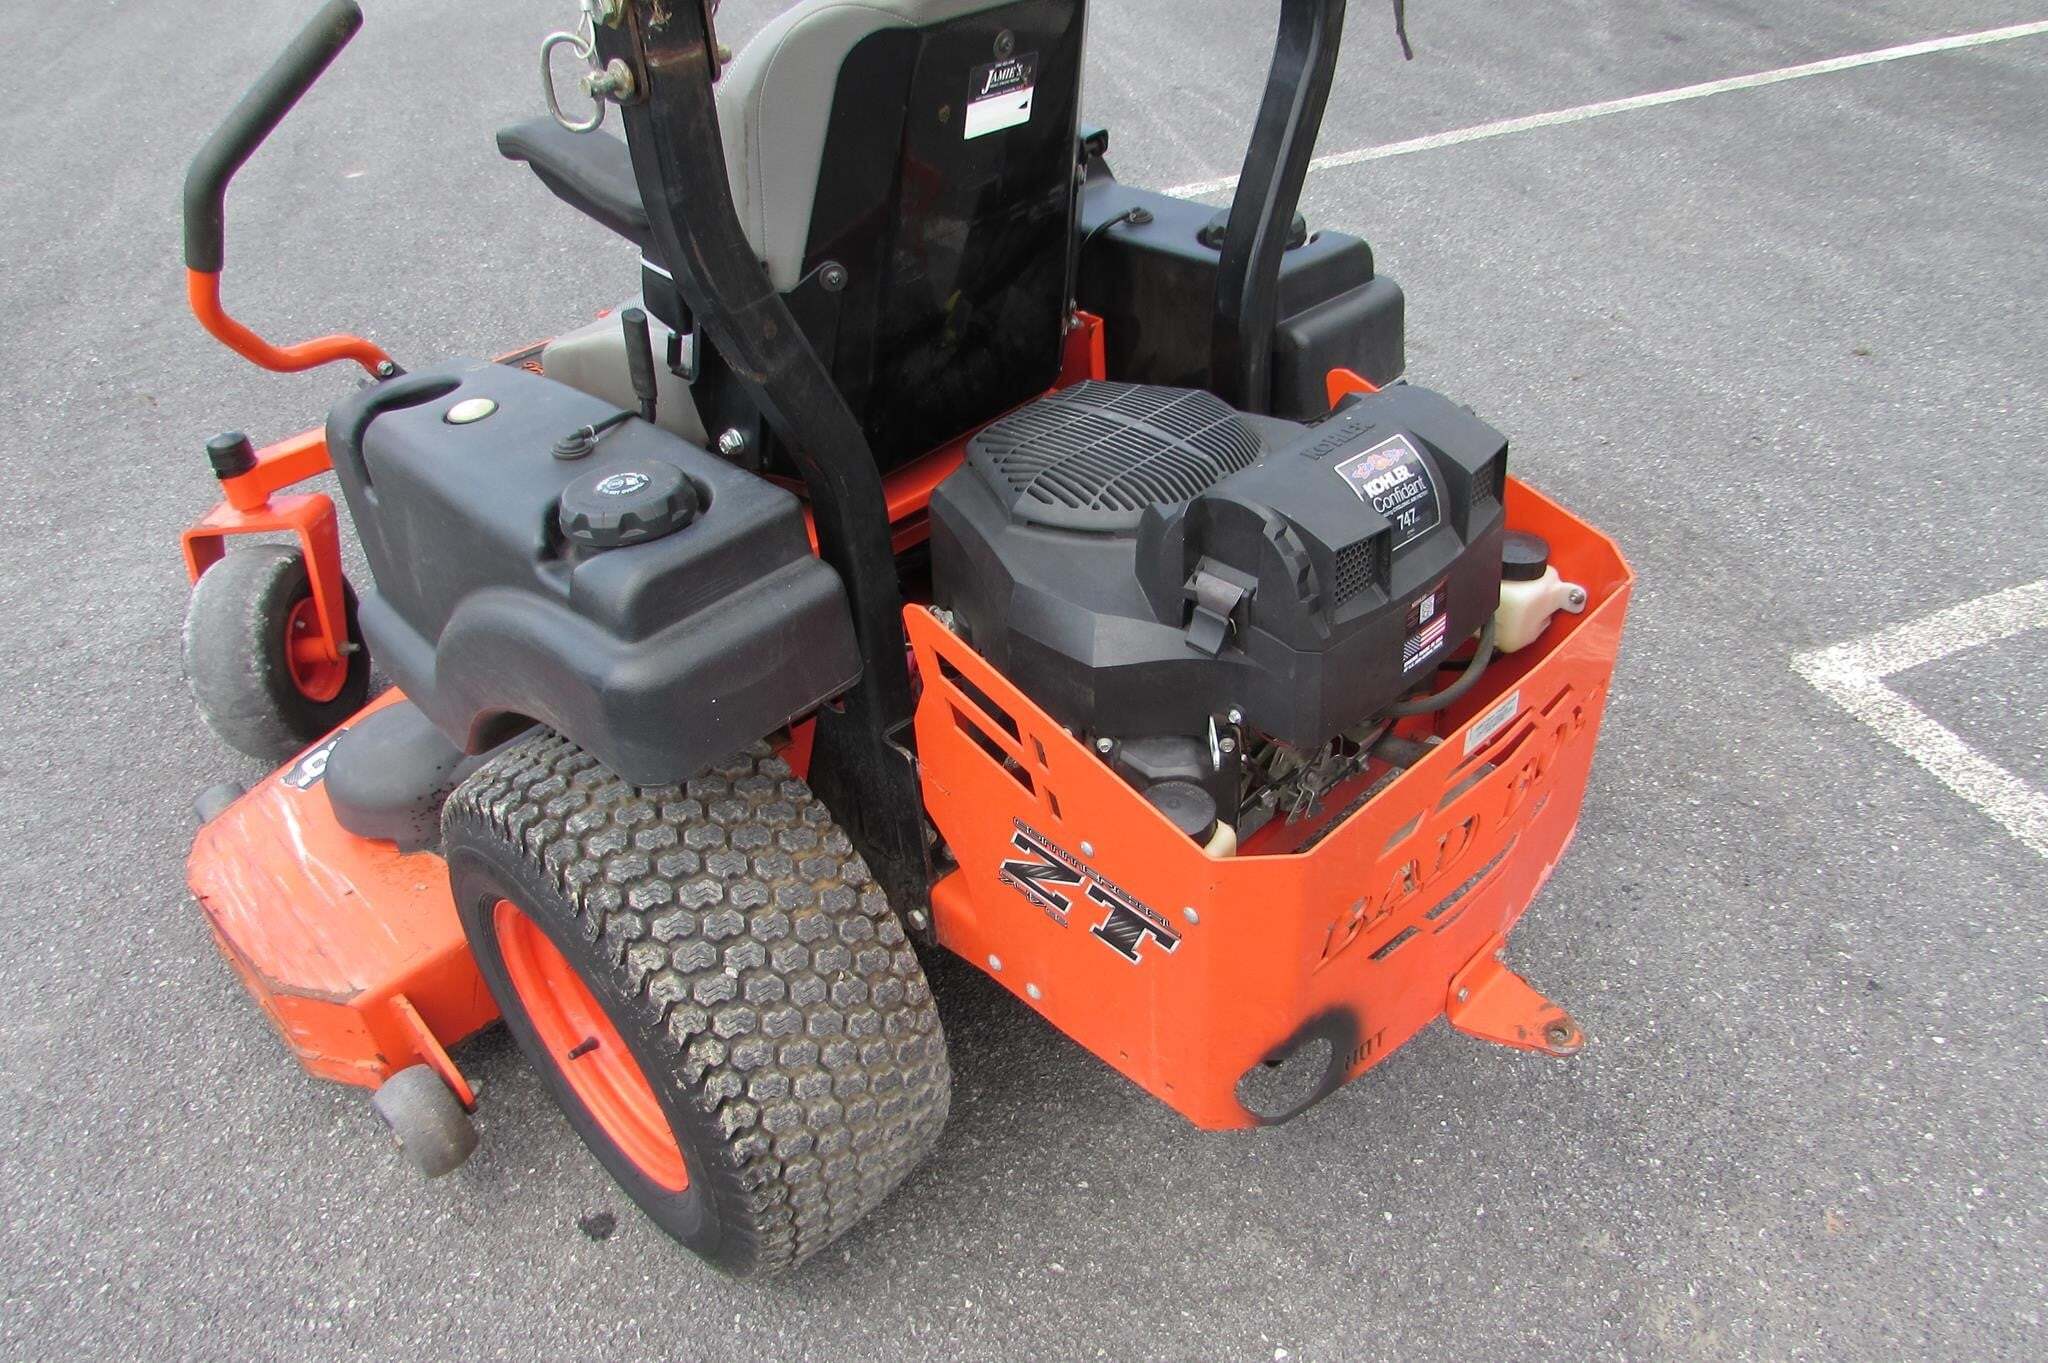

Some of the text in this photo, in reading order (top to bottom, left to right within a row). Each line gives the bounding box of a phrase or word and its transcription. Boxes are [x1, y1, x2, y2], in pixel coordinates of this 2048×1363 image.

[1363, 465, 1415, 498] KOHLER
[1372, 475, 1427, 513] Confidant
[1396, 507, 1416, 531] 747
[999, 829, 1182, 966] ZT
[1344, 1027, 1388, 1072] HOT
